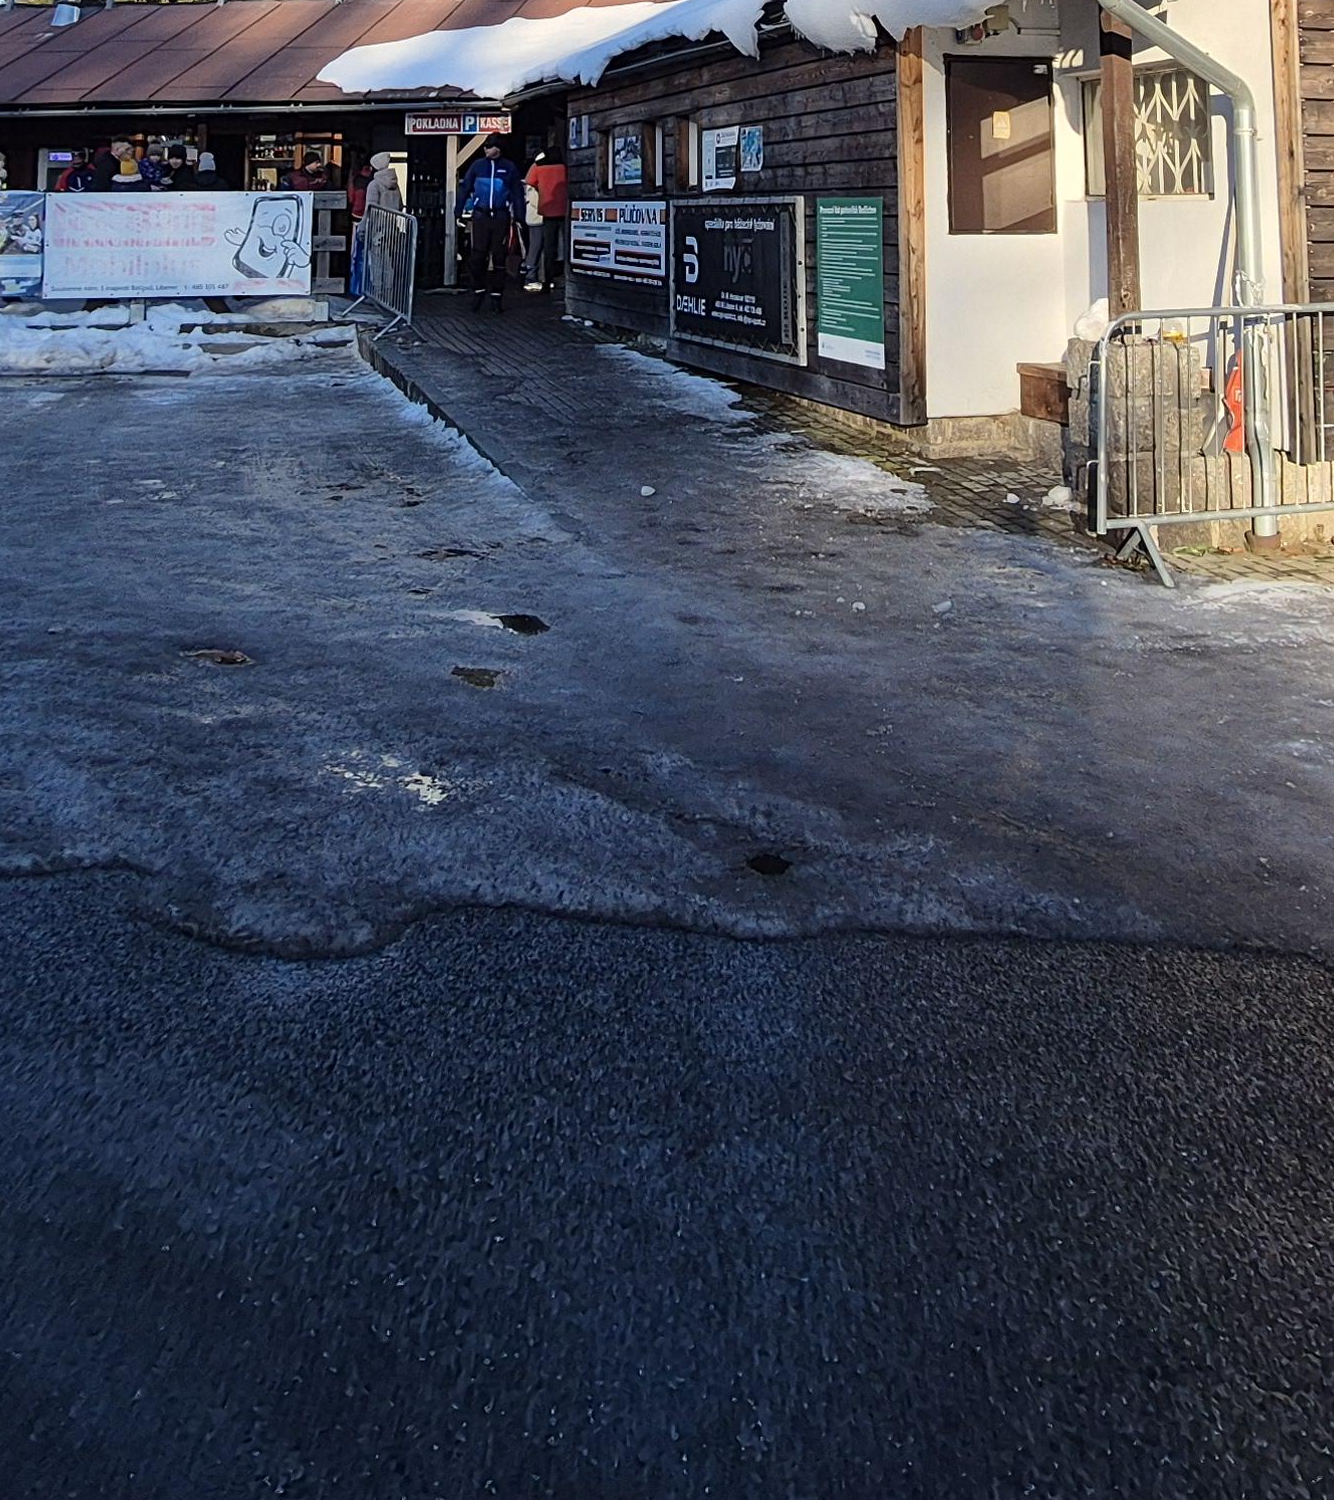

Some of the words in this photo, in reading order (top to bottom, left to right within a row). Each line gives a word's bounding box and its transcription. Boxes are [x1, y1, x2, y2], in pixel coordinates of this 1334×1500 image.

[410, 116, 459, 133] POKLADNA
[464, 115, 475, 131] P
[581, 208, 603, 222] SERVIS
[619, 204, 658, 224] PŮJČOVNA
[676, 294, 706, 316] DÆHLIE
